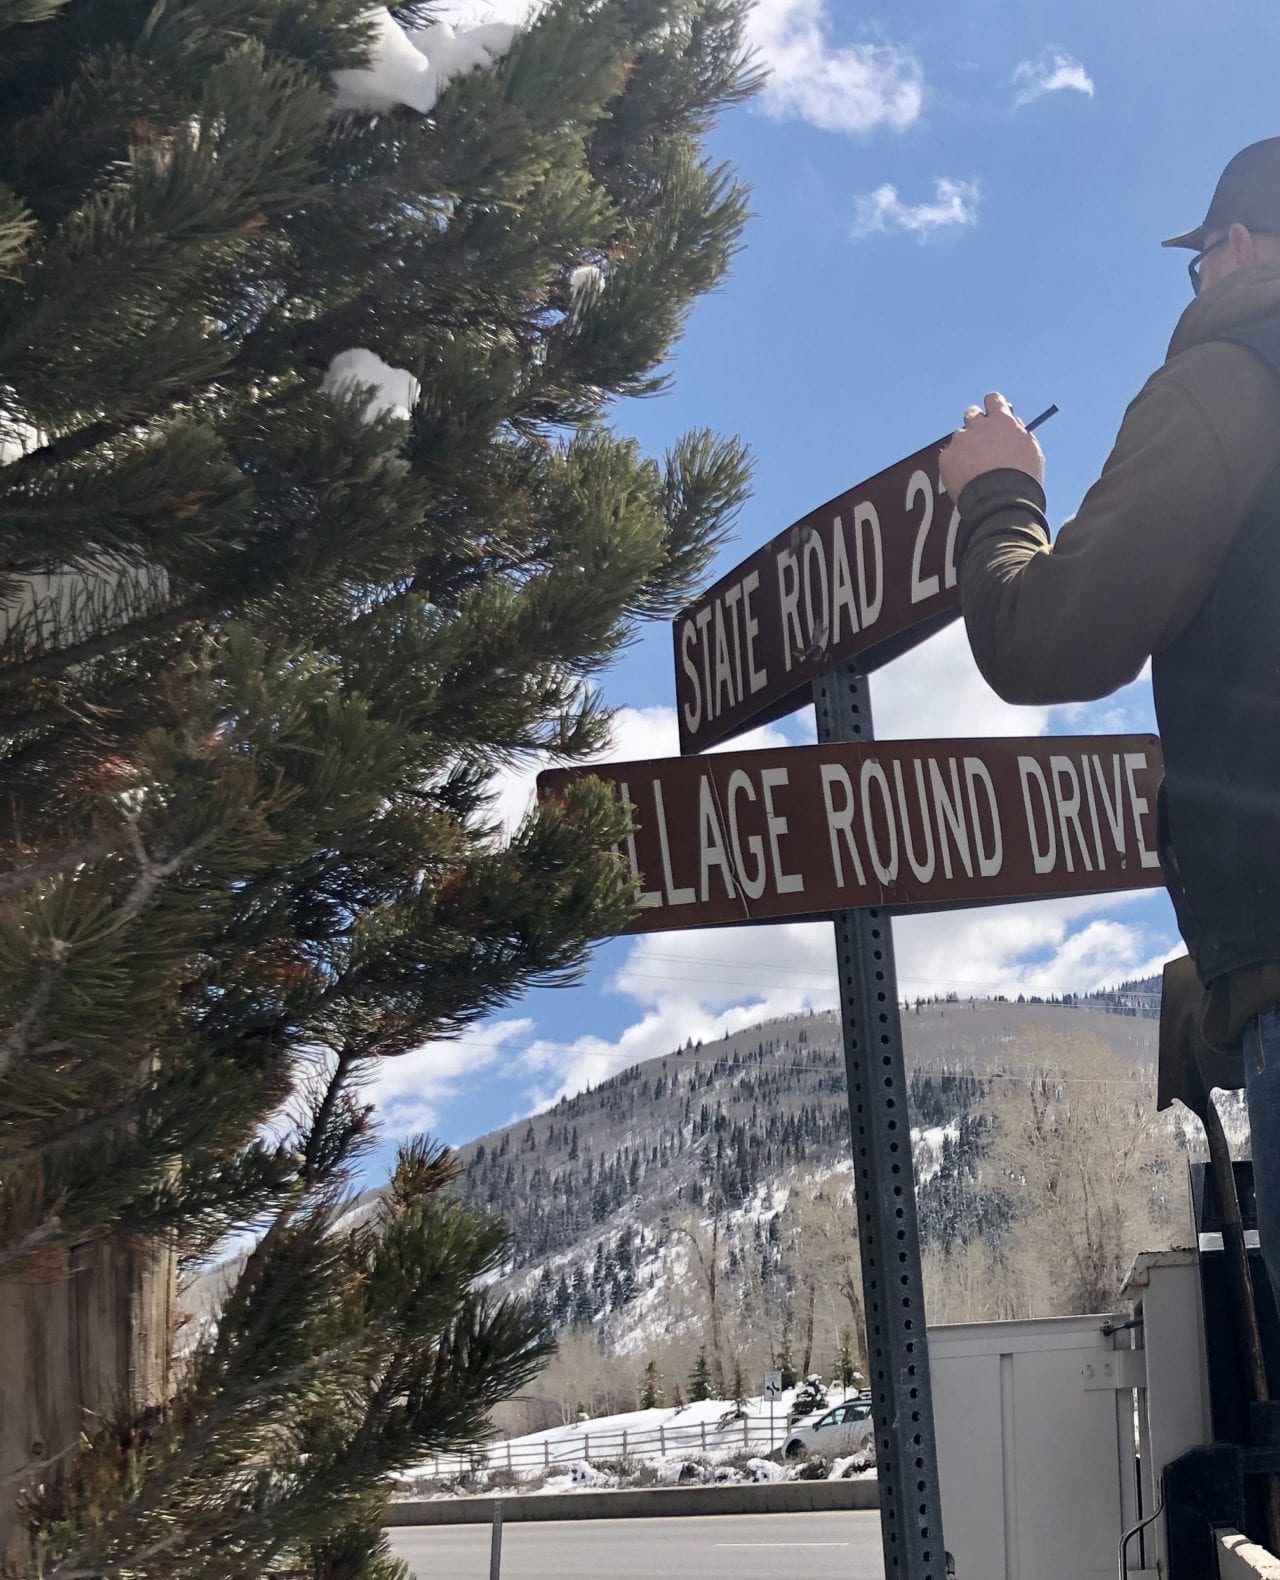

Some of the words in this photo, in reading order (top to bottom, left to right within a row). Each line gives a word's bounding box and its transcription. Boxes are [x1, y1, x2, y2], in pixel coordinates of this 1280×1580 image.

[681, 571, 768, 734] STATE
[778, 501, 883, 672] ROAD
[611, 768, 803, 907] LLAGE
[820, 756, 1002, 887] ROUND
[1017, 752, 1162, 874] DRIVE
